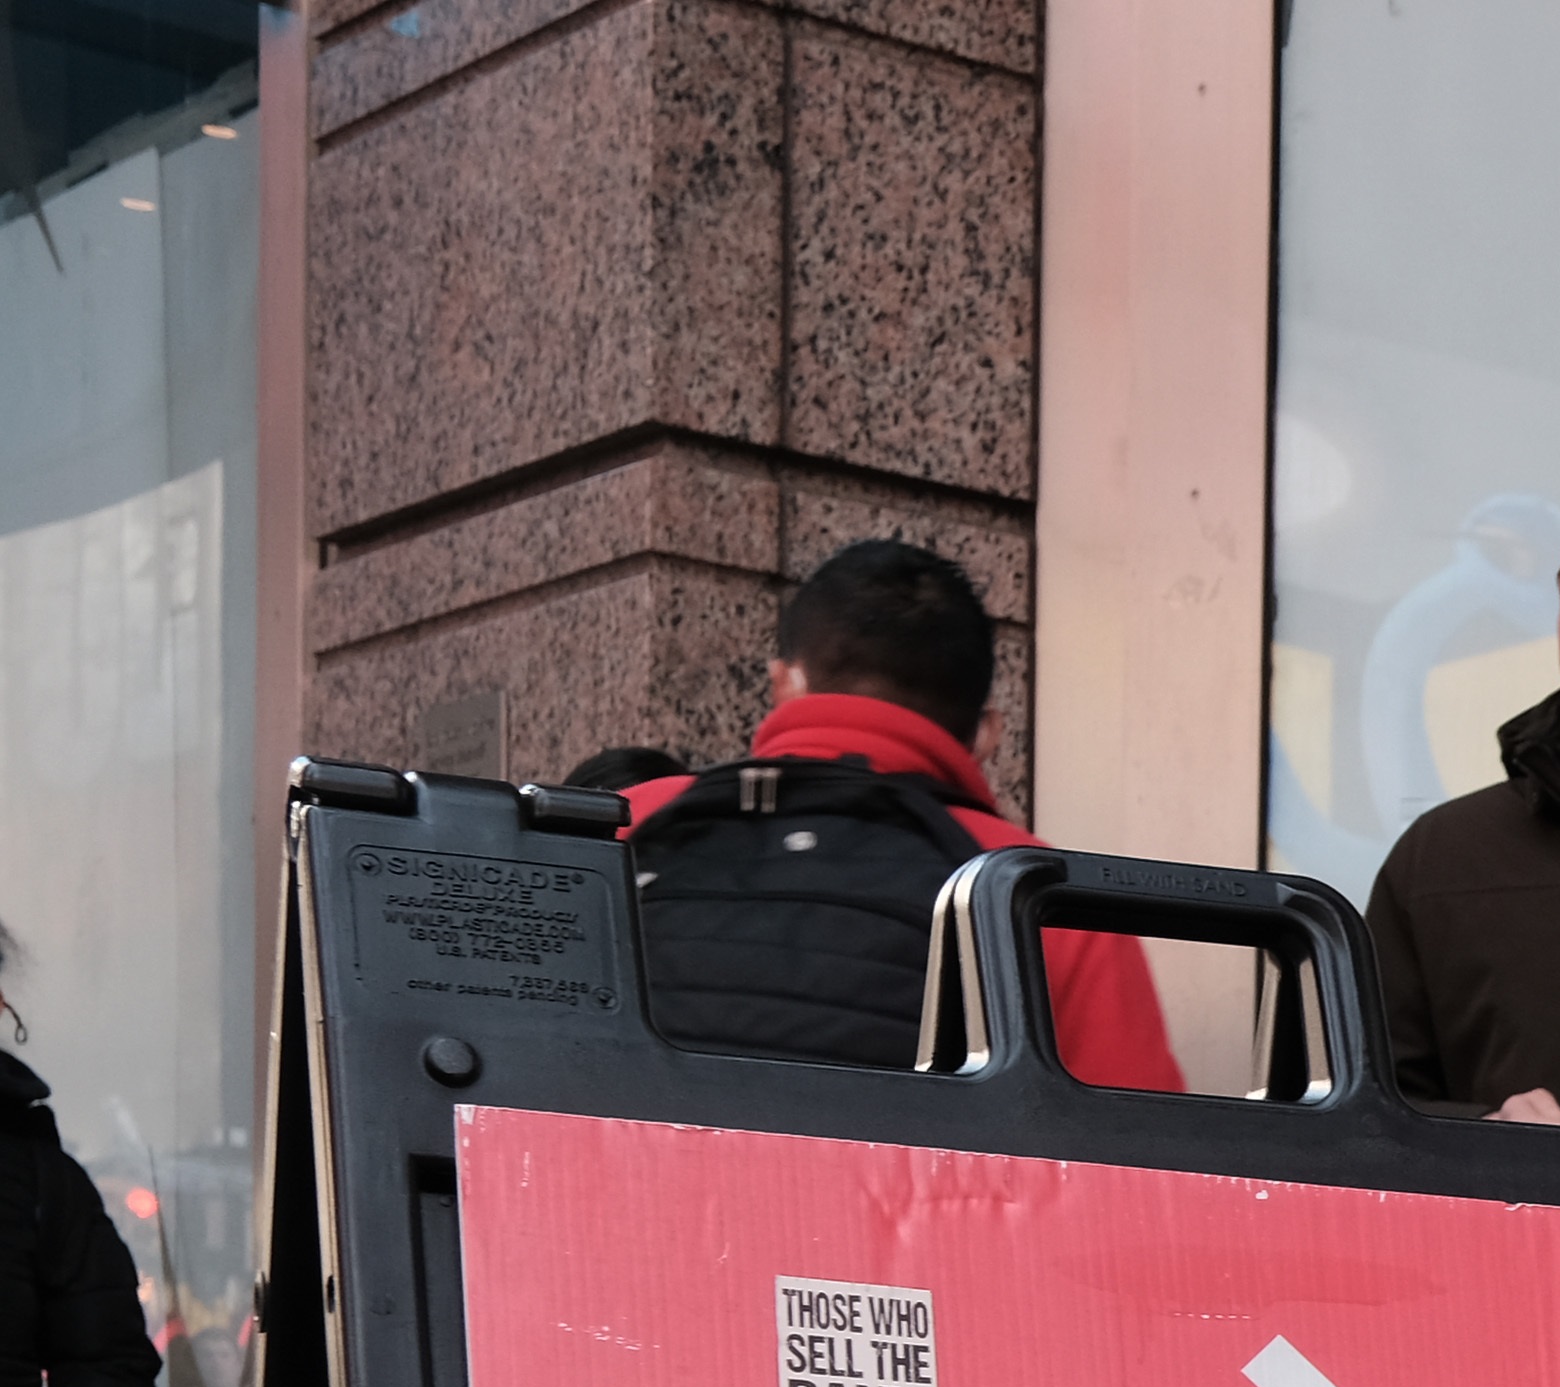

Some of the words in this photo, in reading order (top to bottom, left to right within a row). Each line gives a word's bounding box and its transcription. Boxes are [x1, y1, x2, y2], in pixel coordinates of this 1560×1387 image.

[430, 882, 534, 905] DELUXE
[782, 1288, 863, 1333] THOSE
[869, 1297, 928, 1339] WHO
[786, 1334, 864, 1378] SELL
[870, 1341, 932, 1385] THE
